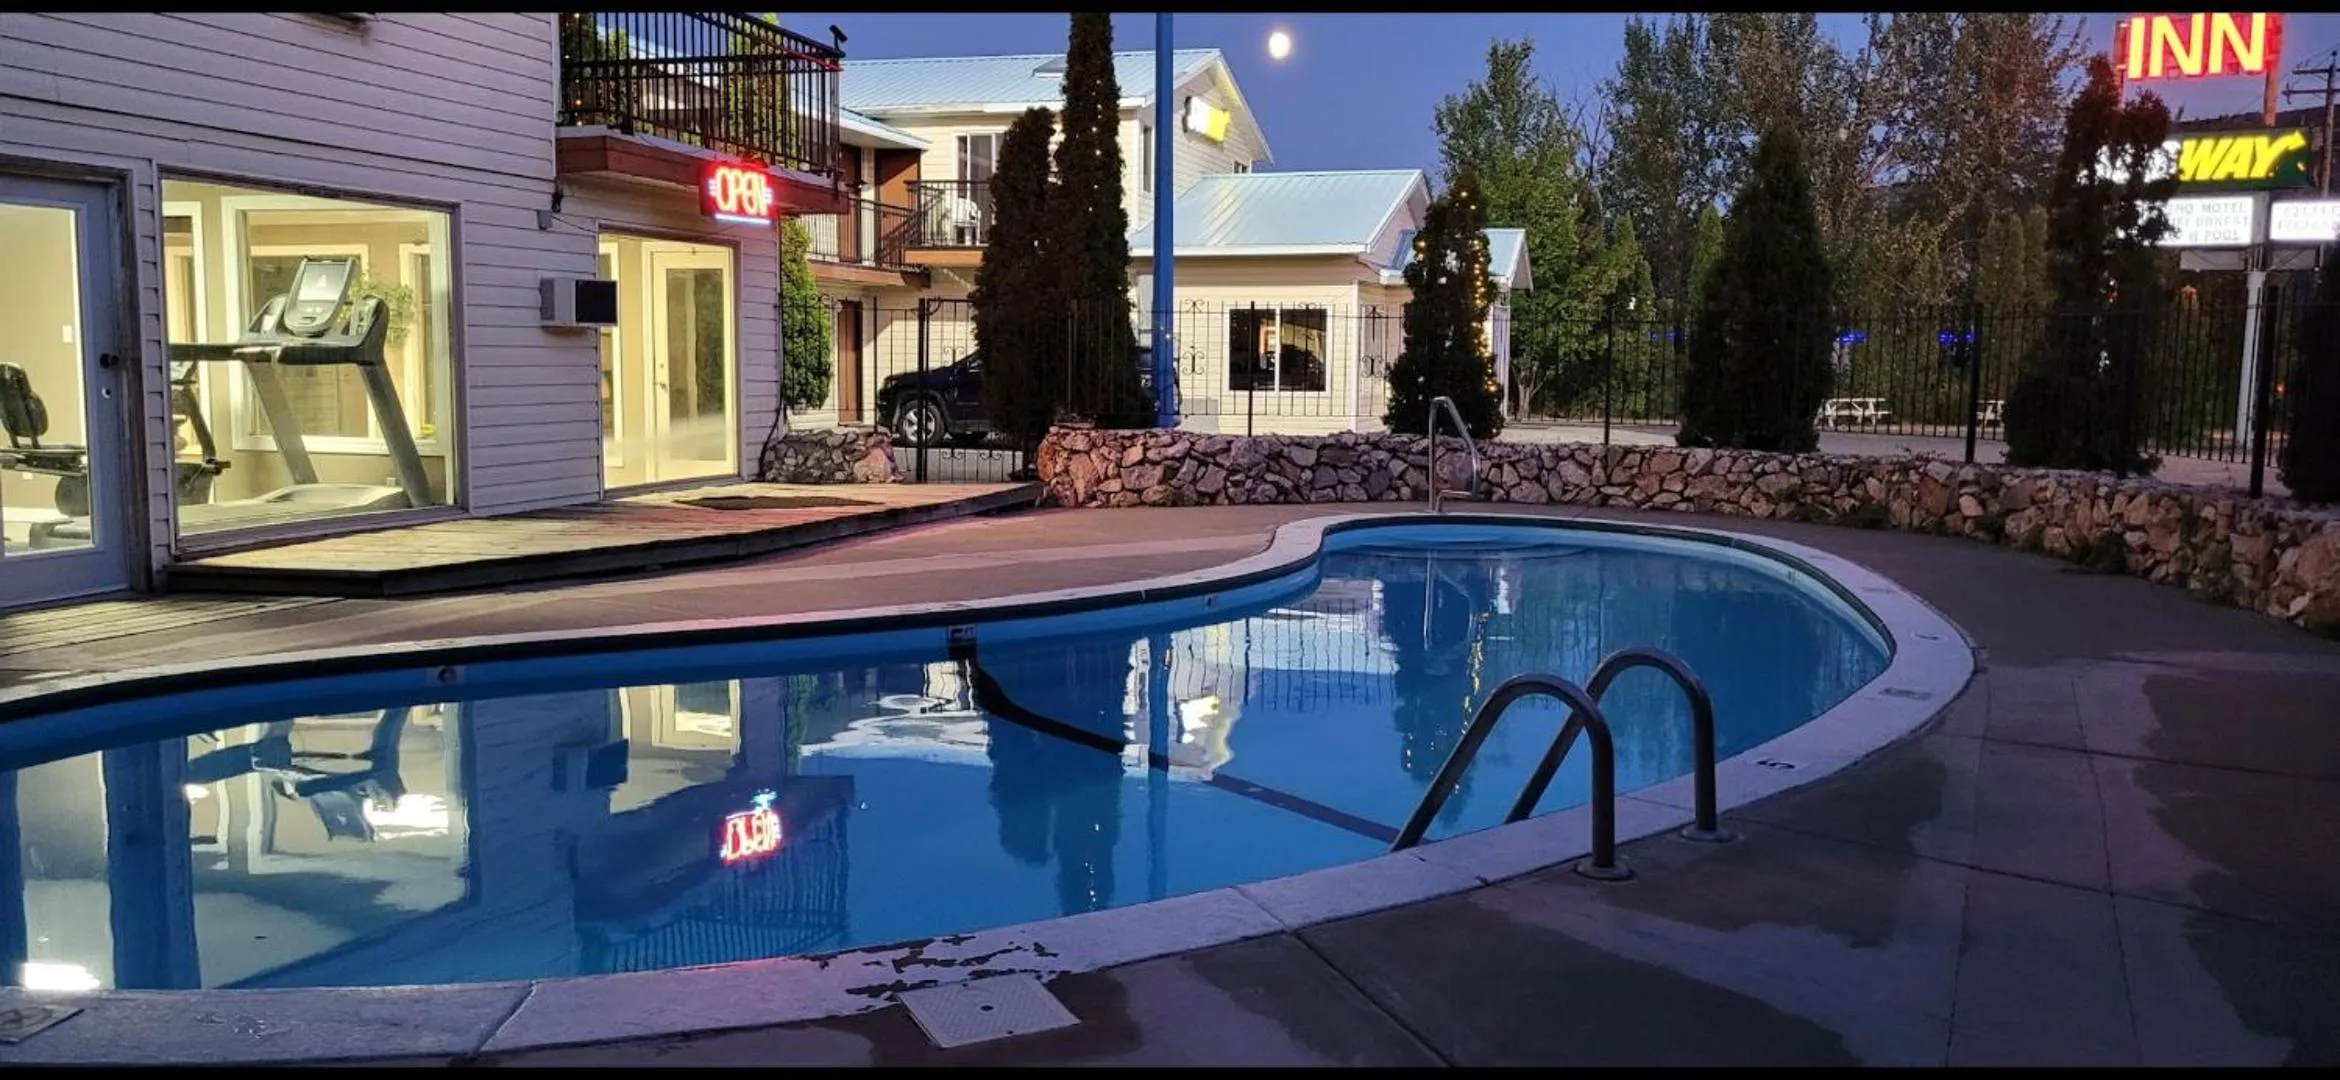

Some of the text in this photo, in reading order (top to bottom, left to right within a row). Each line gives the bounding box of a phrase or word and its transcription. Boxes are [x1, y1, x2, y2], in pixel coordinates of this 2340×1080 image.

[2127, 12, 2266, 79] INN
[715, 166, 767, 216] OPEN
[2201, 202, 2246, 213] MOTEL
[2204, 229, 2240, 242] POOL
